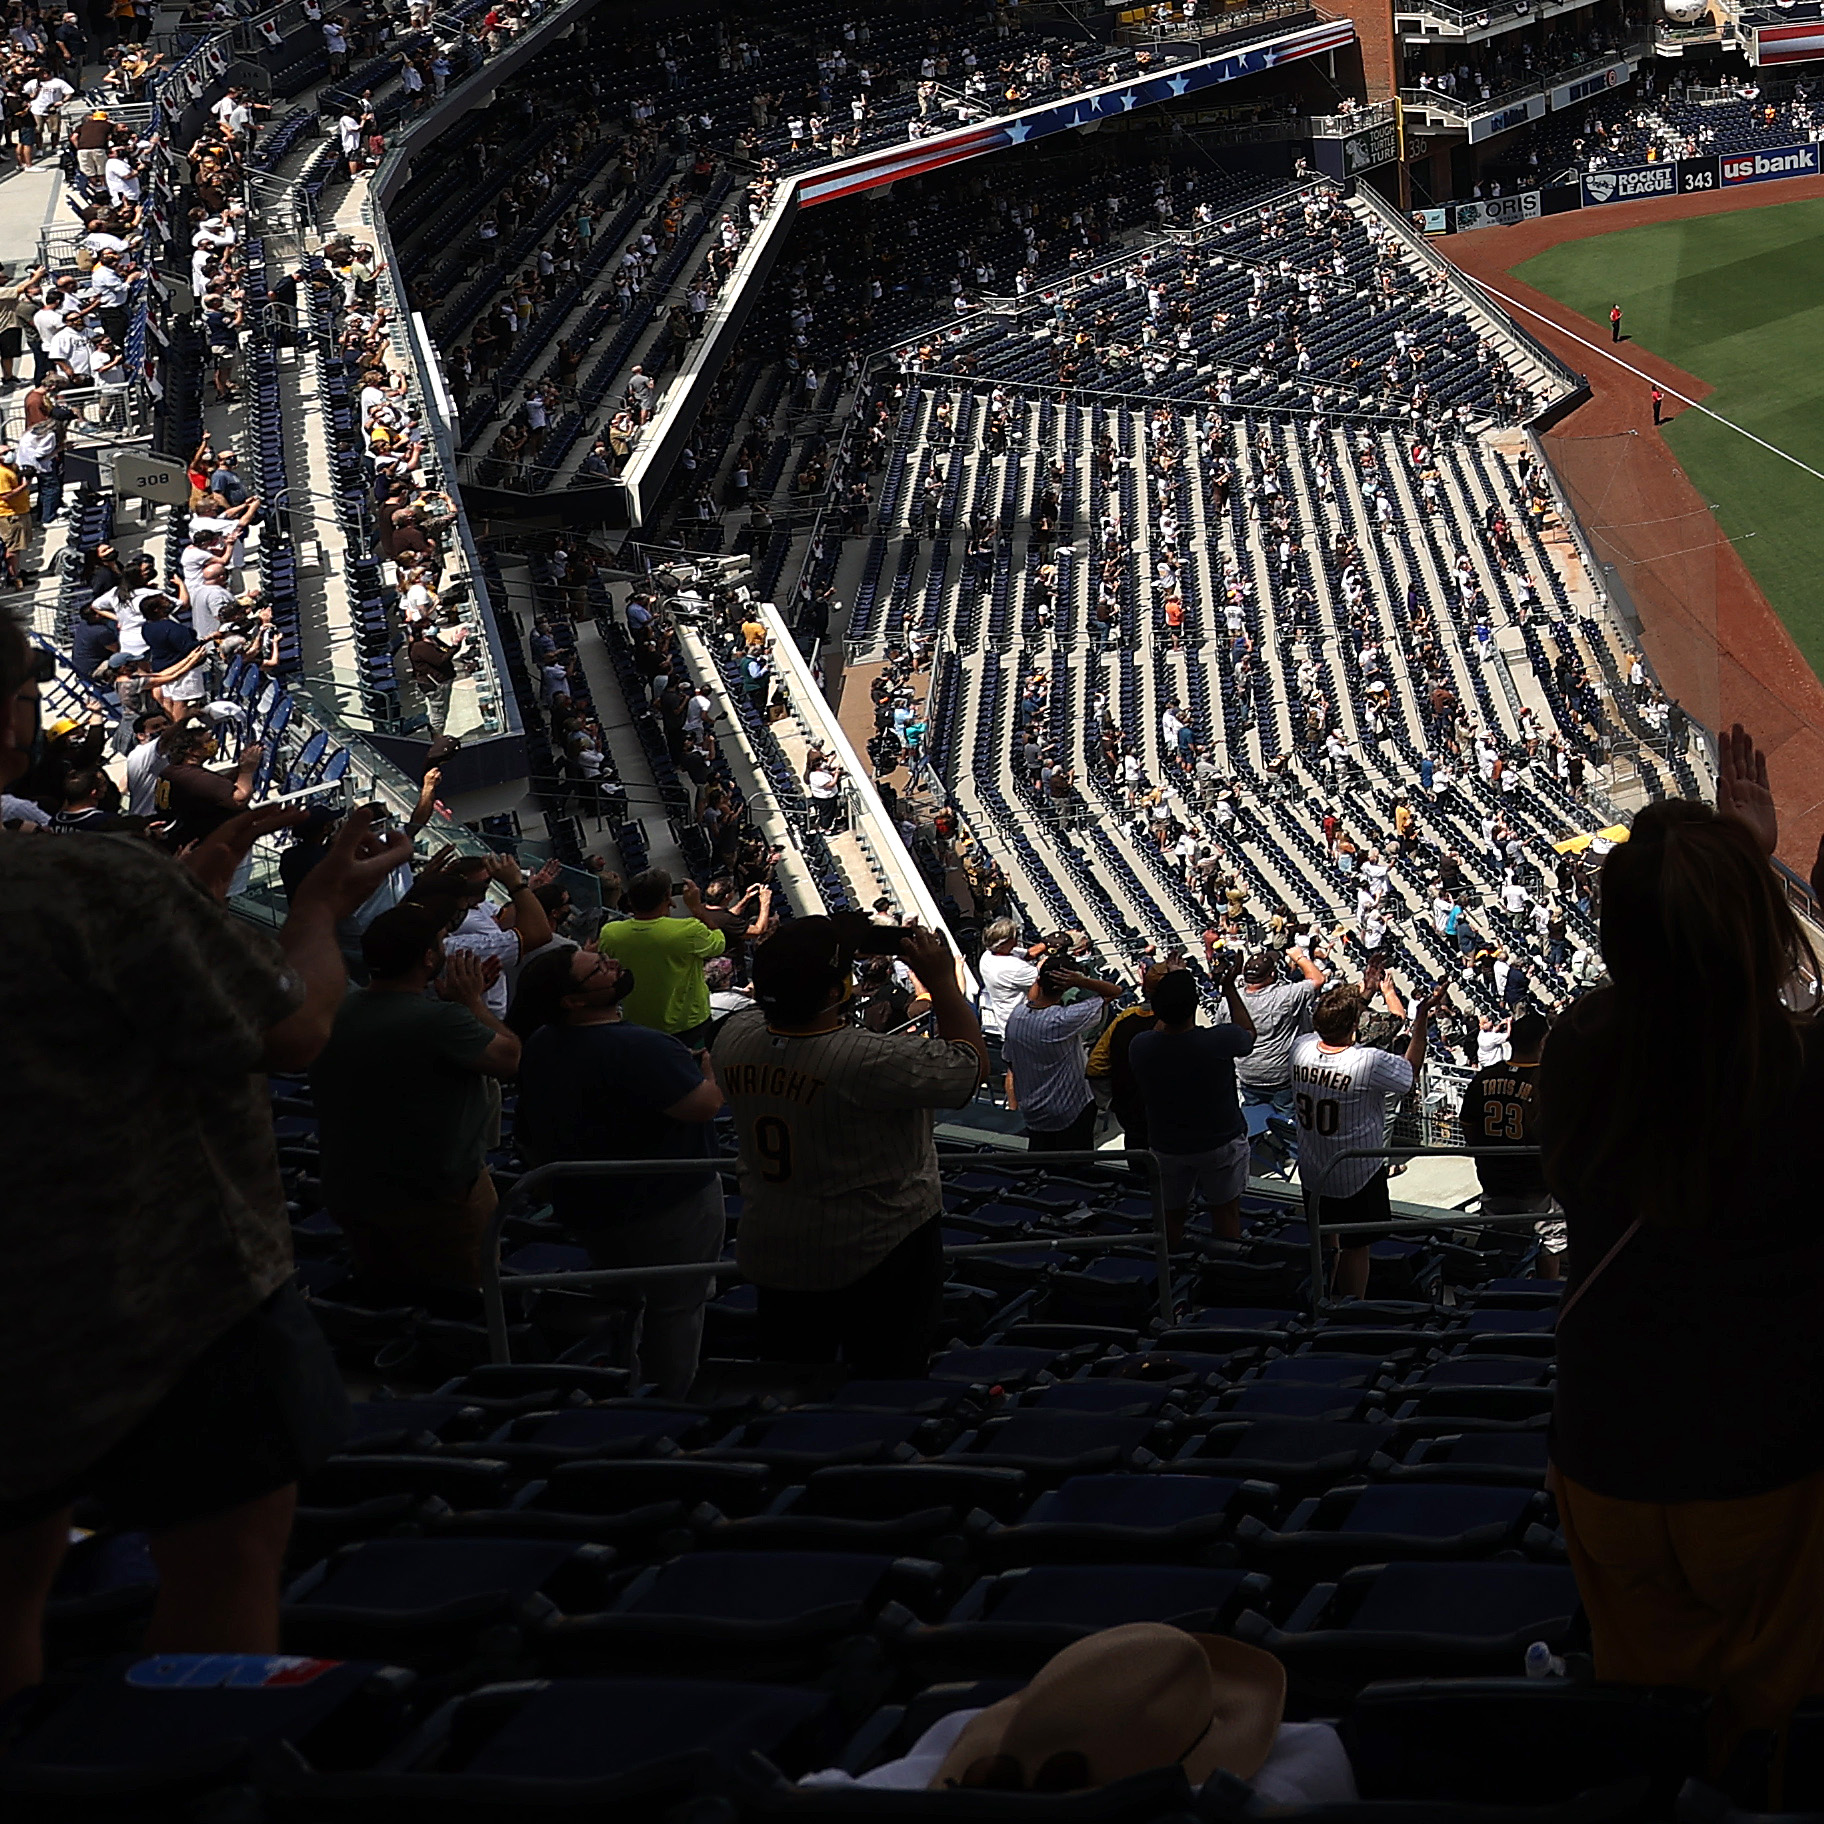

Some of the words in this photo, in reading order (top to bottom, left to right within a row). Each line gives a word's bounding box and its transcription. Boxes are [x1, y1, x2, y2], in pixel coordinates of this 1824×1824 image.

[1369, 123, 1396, 139] TOUGH
[1369, 135, 1397, 153] TURTLE
[1408, 136, 1428, 159] 336
[1370, 147, 1396, 165] TURF
[1618, 167, 1673, 185] ROCKET
[1685, 172, 1712, 190] 343
[1618, 179, 1672, 196] LEAGUE
[1485, 194, 1538, 219] ORIS
[137, 473, 169, 487] 308
[723, 1064, 826, 1104] WRIGHT
[1293, 1064, 1352, 1092] HOSMER
[1481, 1077, 1516, 1097] TATIS
[1296, 1093, 1340, 1137] 30
[1483, 1100, 1524, 1141] 23
[753, 1113, 793, 1184] 9
